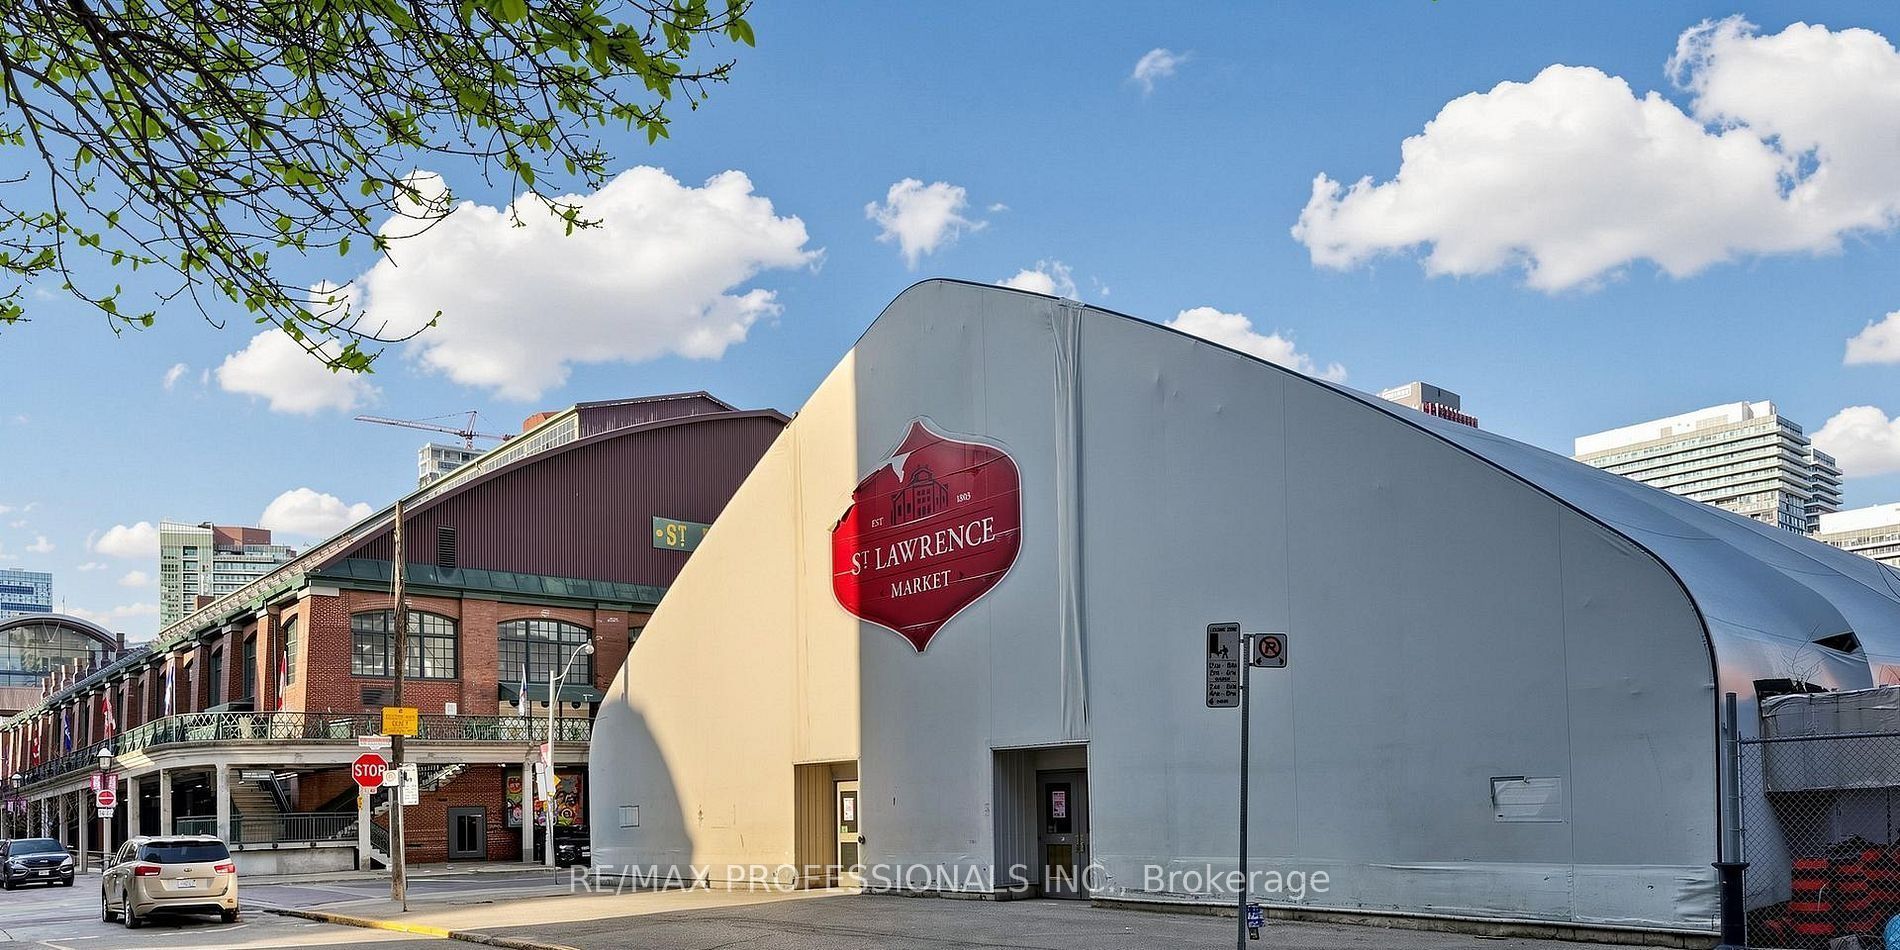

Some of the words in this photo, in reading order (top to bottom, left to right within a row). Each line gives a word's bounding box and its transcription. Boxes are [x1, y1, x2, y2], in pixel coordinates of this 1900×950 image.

[871, 517, 884, 528] EST
[875, 516, 996, 570] LAWRENCE
[891, 569, 951, 598] MARKET
[354, 763, 386, 777] STOP
